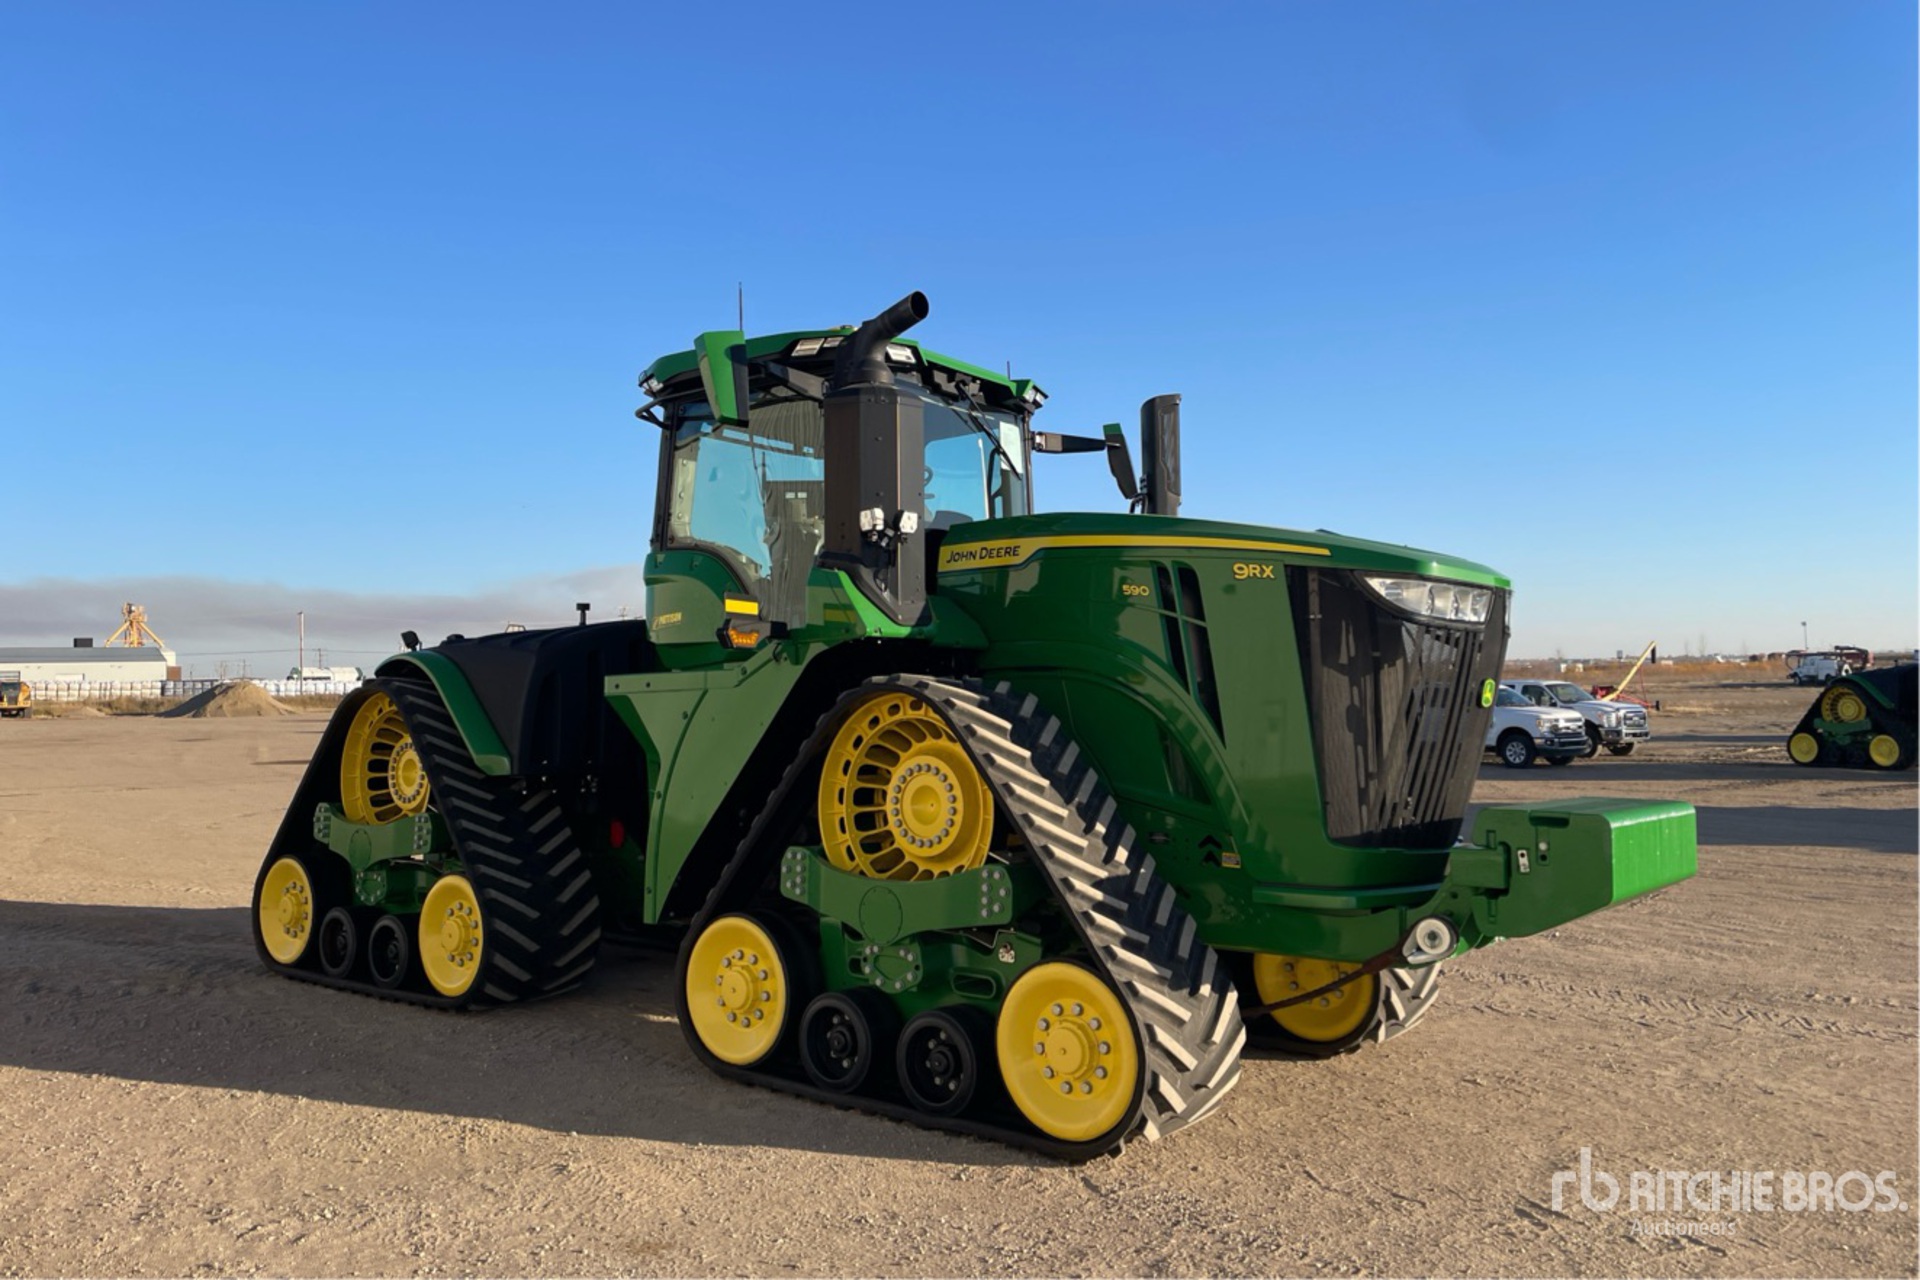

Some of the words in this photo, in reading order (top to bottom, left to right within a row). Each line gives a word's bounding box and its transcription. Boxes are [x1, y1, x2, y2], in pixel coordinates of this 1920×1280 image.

[946, 550, 977, 563] JOHN
[979, 545, 1021, 560] DEERE
[1232, 562, 1275, 580] 9RX
[1122, 584, 1149, 596] 590
